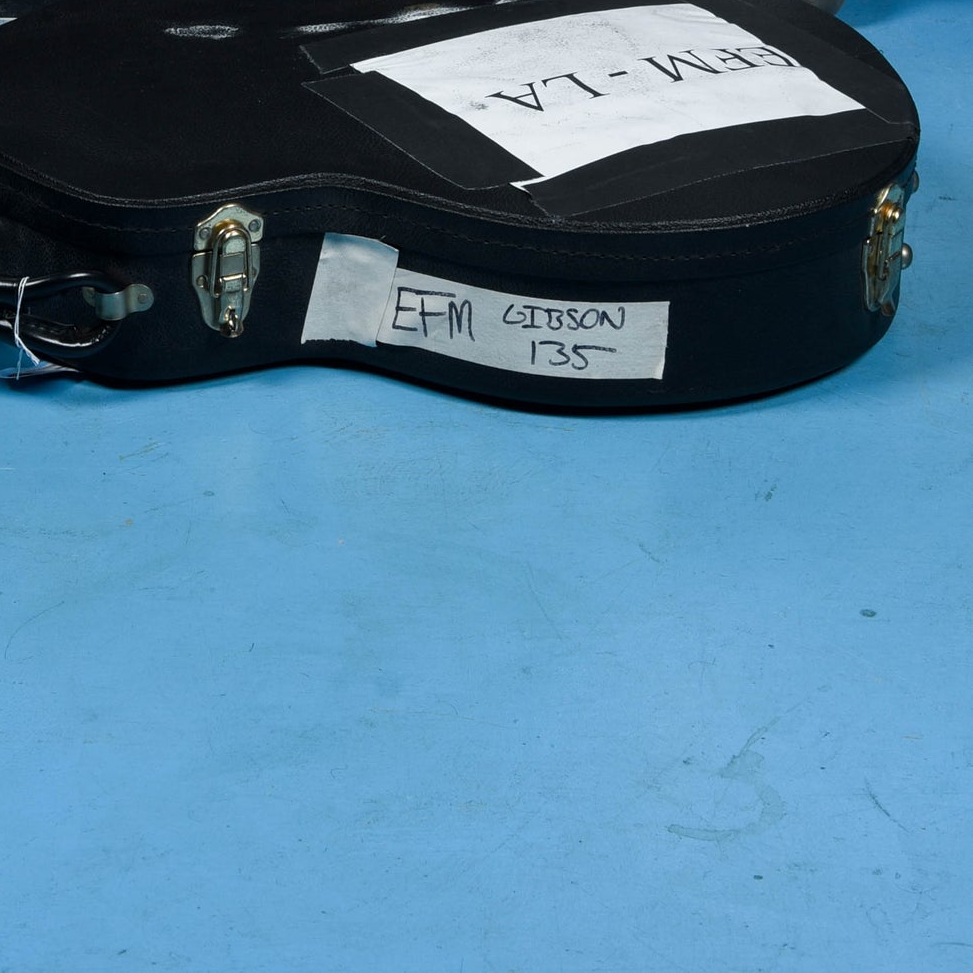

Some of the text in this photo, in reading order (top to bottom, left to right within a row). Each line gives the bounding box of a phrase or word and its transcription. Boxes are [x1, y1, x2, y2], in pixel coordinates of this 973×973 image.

[485, 71, 611, 113] LA
[391, 286, 626, 342] EFM GIBSON
[530, 340, 617, 370] 135
